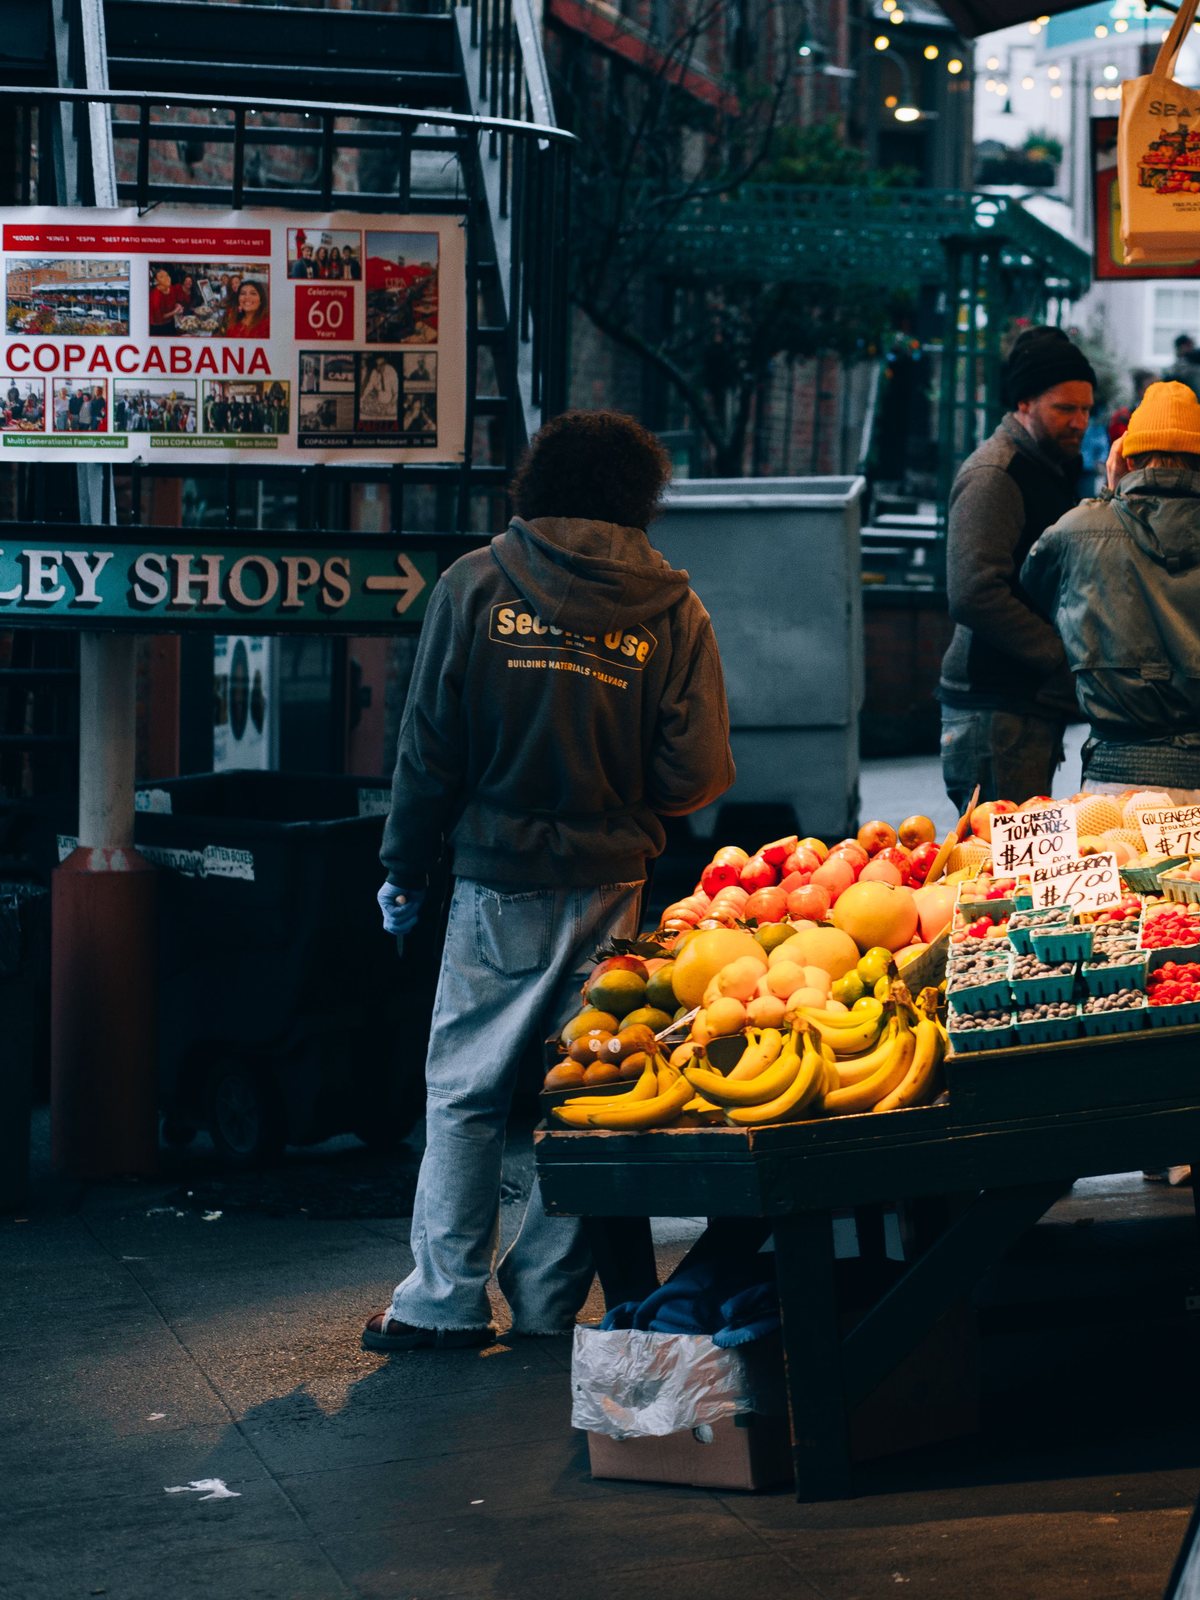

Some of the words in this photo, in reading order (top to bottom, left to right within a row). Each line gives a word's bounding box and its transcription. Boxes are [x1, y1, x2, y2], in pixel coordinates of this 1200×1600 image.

[190, 238, 217, 246] SEATTLE
[307, 287, 348, 299] Celebrating
[308, 300, 344, 329] 60
[315, 329, 337, 338] Years
[5, 342, 272, 375] COPACABANA
[7, 437, 26, 445] Multi
[26, 438, 73, 447] Generational
[170, 439, 191, 447] COPA
[191, 440, 225, 448] AMERICA
[133, 552, 351, 608] SHOPS
[507, 659, 547, 669] BUILDING
[548, 660, 591, 676] MATERIALS
[993, 814, 1016, 829] MIX
[1021, 807, 1064, 825] CHERRY
[1002, 819, 1071, 842] TOMATOES
[1033, 855, 1113, 882] BLUEBERRY
[1095, 890, 1119, 906] BOX
